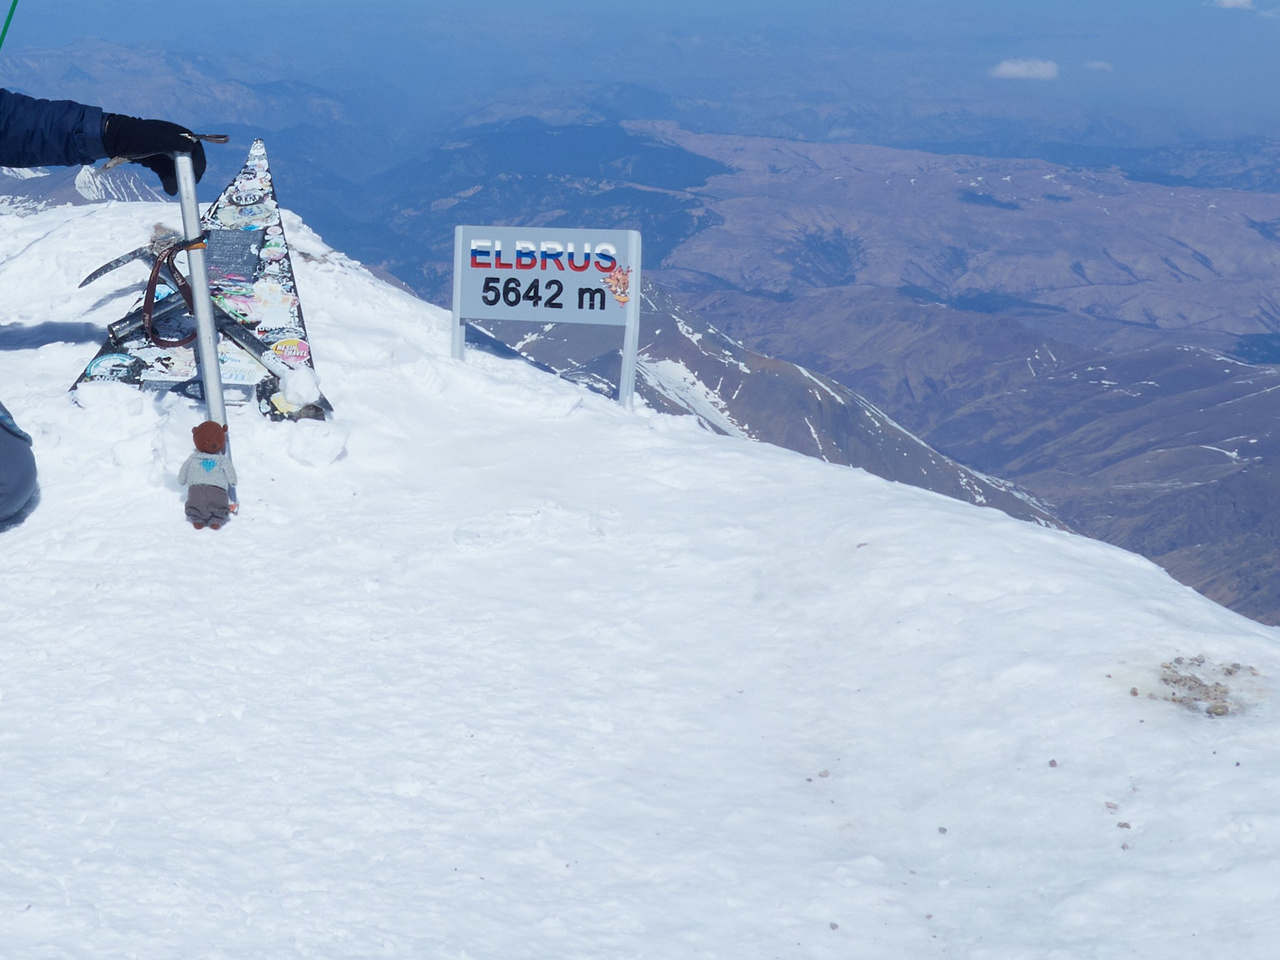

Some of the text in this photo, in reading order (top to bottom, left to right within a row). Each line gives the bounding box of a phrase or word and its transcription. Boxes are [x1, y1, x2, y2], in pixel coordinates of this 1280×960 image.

[470, 239, 617, 273] ELBRUS
[482, 277, 606, 310] 5642 m
